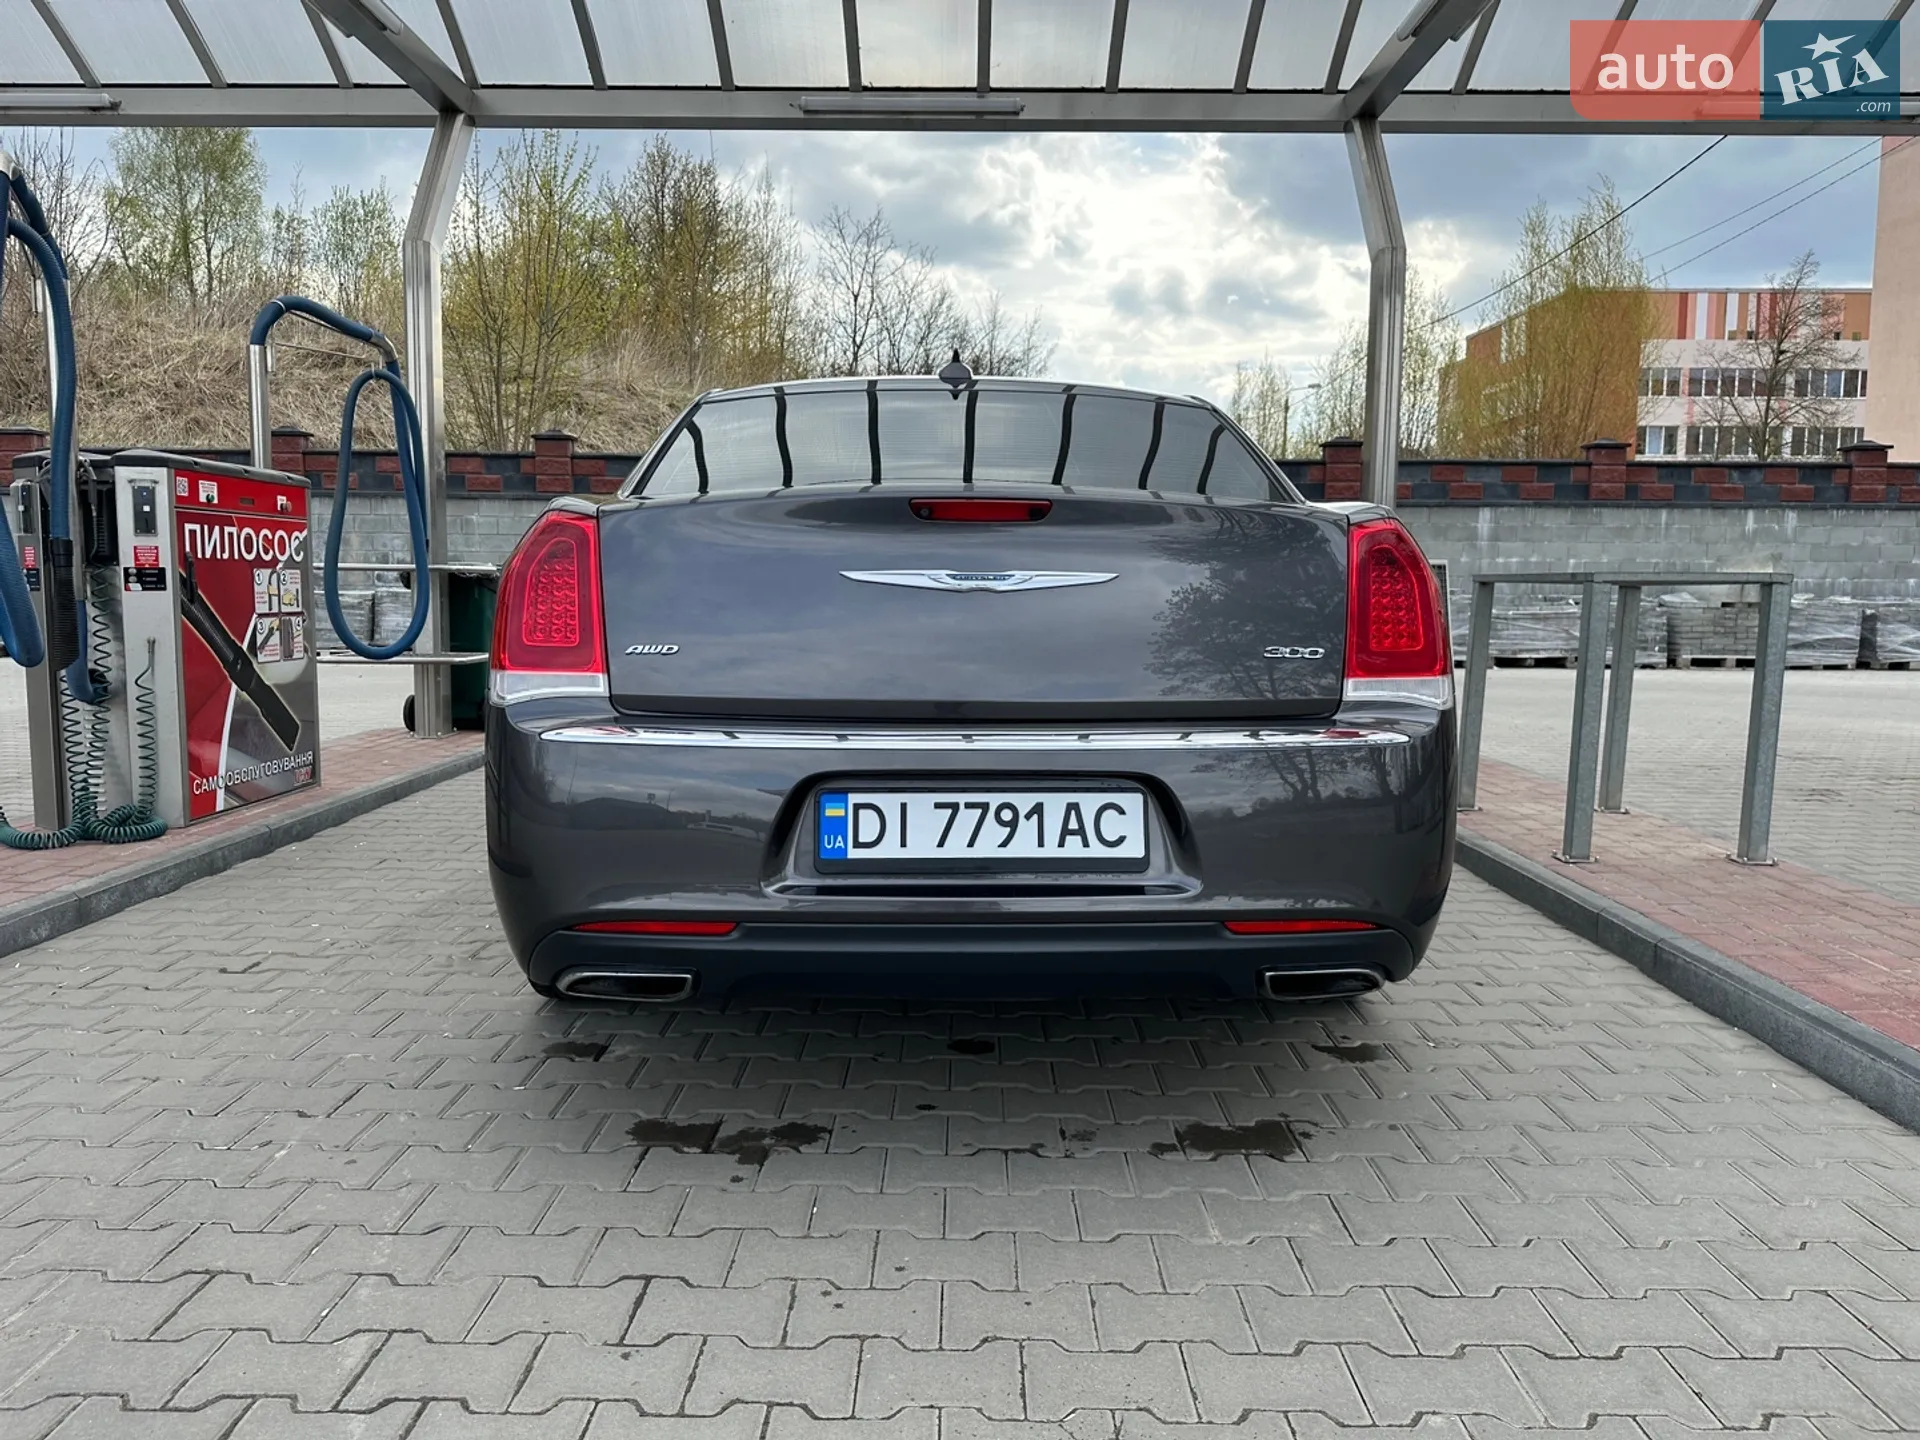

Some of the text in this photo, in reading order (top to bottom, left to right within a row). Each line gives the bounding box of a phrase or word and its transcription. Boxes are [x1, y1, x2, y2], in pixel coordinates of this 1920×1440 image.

[184, 523, 304, 562] ПИЛОСОС
[624, 644, 679, 656] AWD
[1263, 646, 1325, 659] 300
[193, 751, 314, 795] САМООБСЛУГОВУВАННЯ
[852, 802, 907, 849] DI
[824, 835, 845, 849] UA
